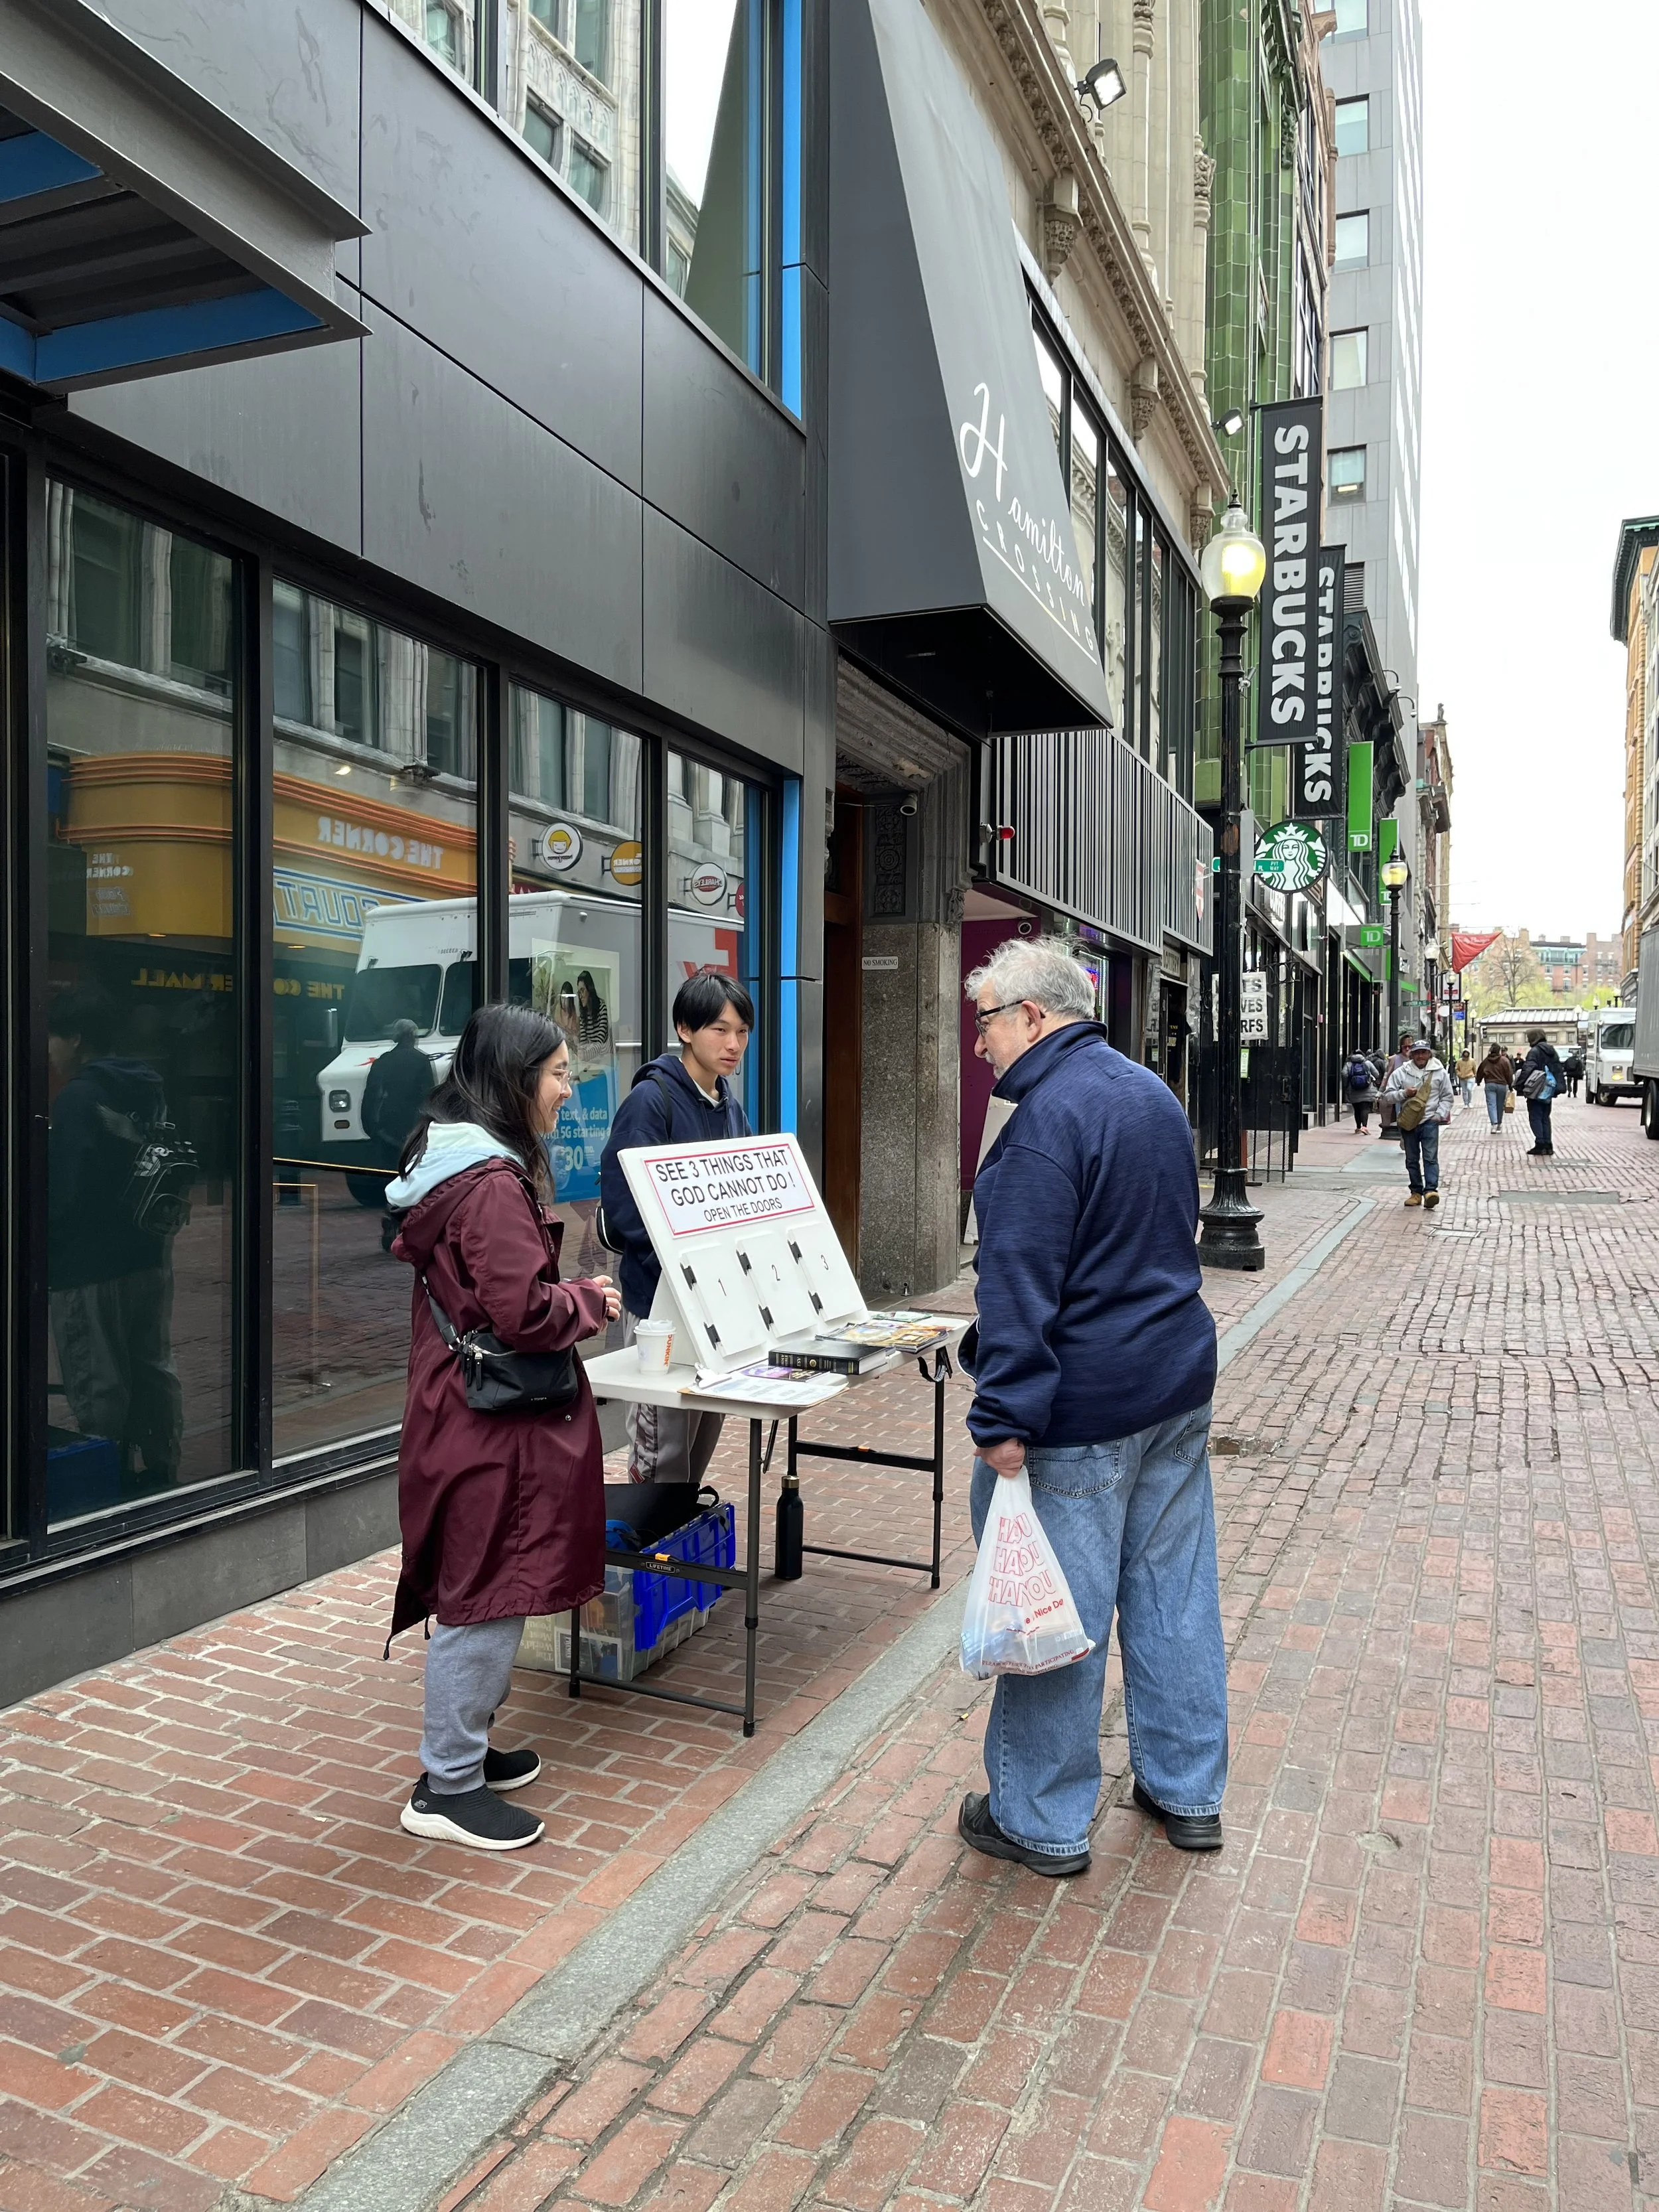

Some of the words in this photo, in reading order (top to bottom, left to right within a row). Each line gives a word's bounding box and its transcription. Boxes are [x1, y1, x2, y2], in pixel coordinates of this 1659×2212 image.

[960, 382, 1086, 607] Hamilton
[975, 499, 1094, 652] CROSSING
[1270, 423, 1310, 726] STARBUCKS
[1350, 834, 1369, 847] TD
[1363, 930, 1382, 942] TD
[561, 1108, 581, 1122] text,
[582, 1107, 589, 1120] &
[590, 1106, 608, 1120] data
[561, 1125, 572, 1139] 5G
[573, 1124, 606, 1141] starting
[655, 1161, 686, 1182] SEE
[689, 1160, 700, 1178] 3
[699, 1153, 754, 1177] THINGS
[753, 1149, 788, 1168] THAT
[670, 1184, 705, 1207] GOD
[707, 1176, 765, 1201] CANNOT
[766, 1173, 788, 1193] DO
[788, 1172, 796, 1188] !
[703, 1205, 731, 1222] OPEN
[730, 1202, 751, 1218] THE
[751, 1197, 782, 1214] DOORS
[821, 1254, 829, 1270] 3
[771, 1264, 781, 1282] 2
[718, 1278, 727, 1296] 1
[1034, 1605, 1052, 1618] Nice
[1035, 1649, 1074, 1669] PARTICIPATING
